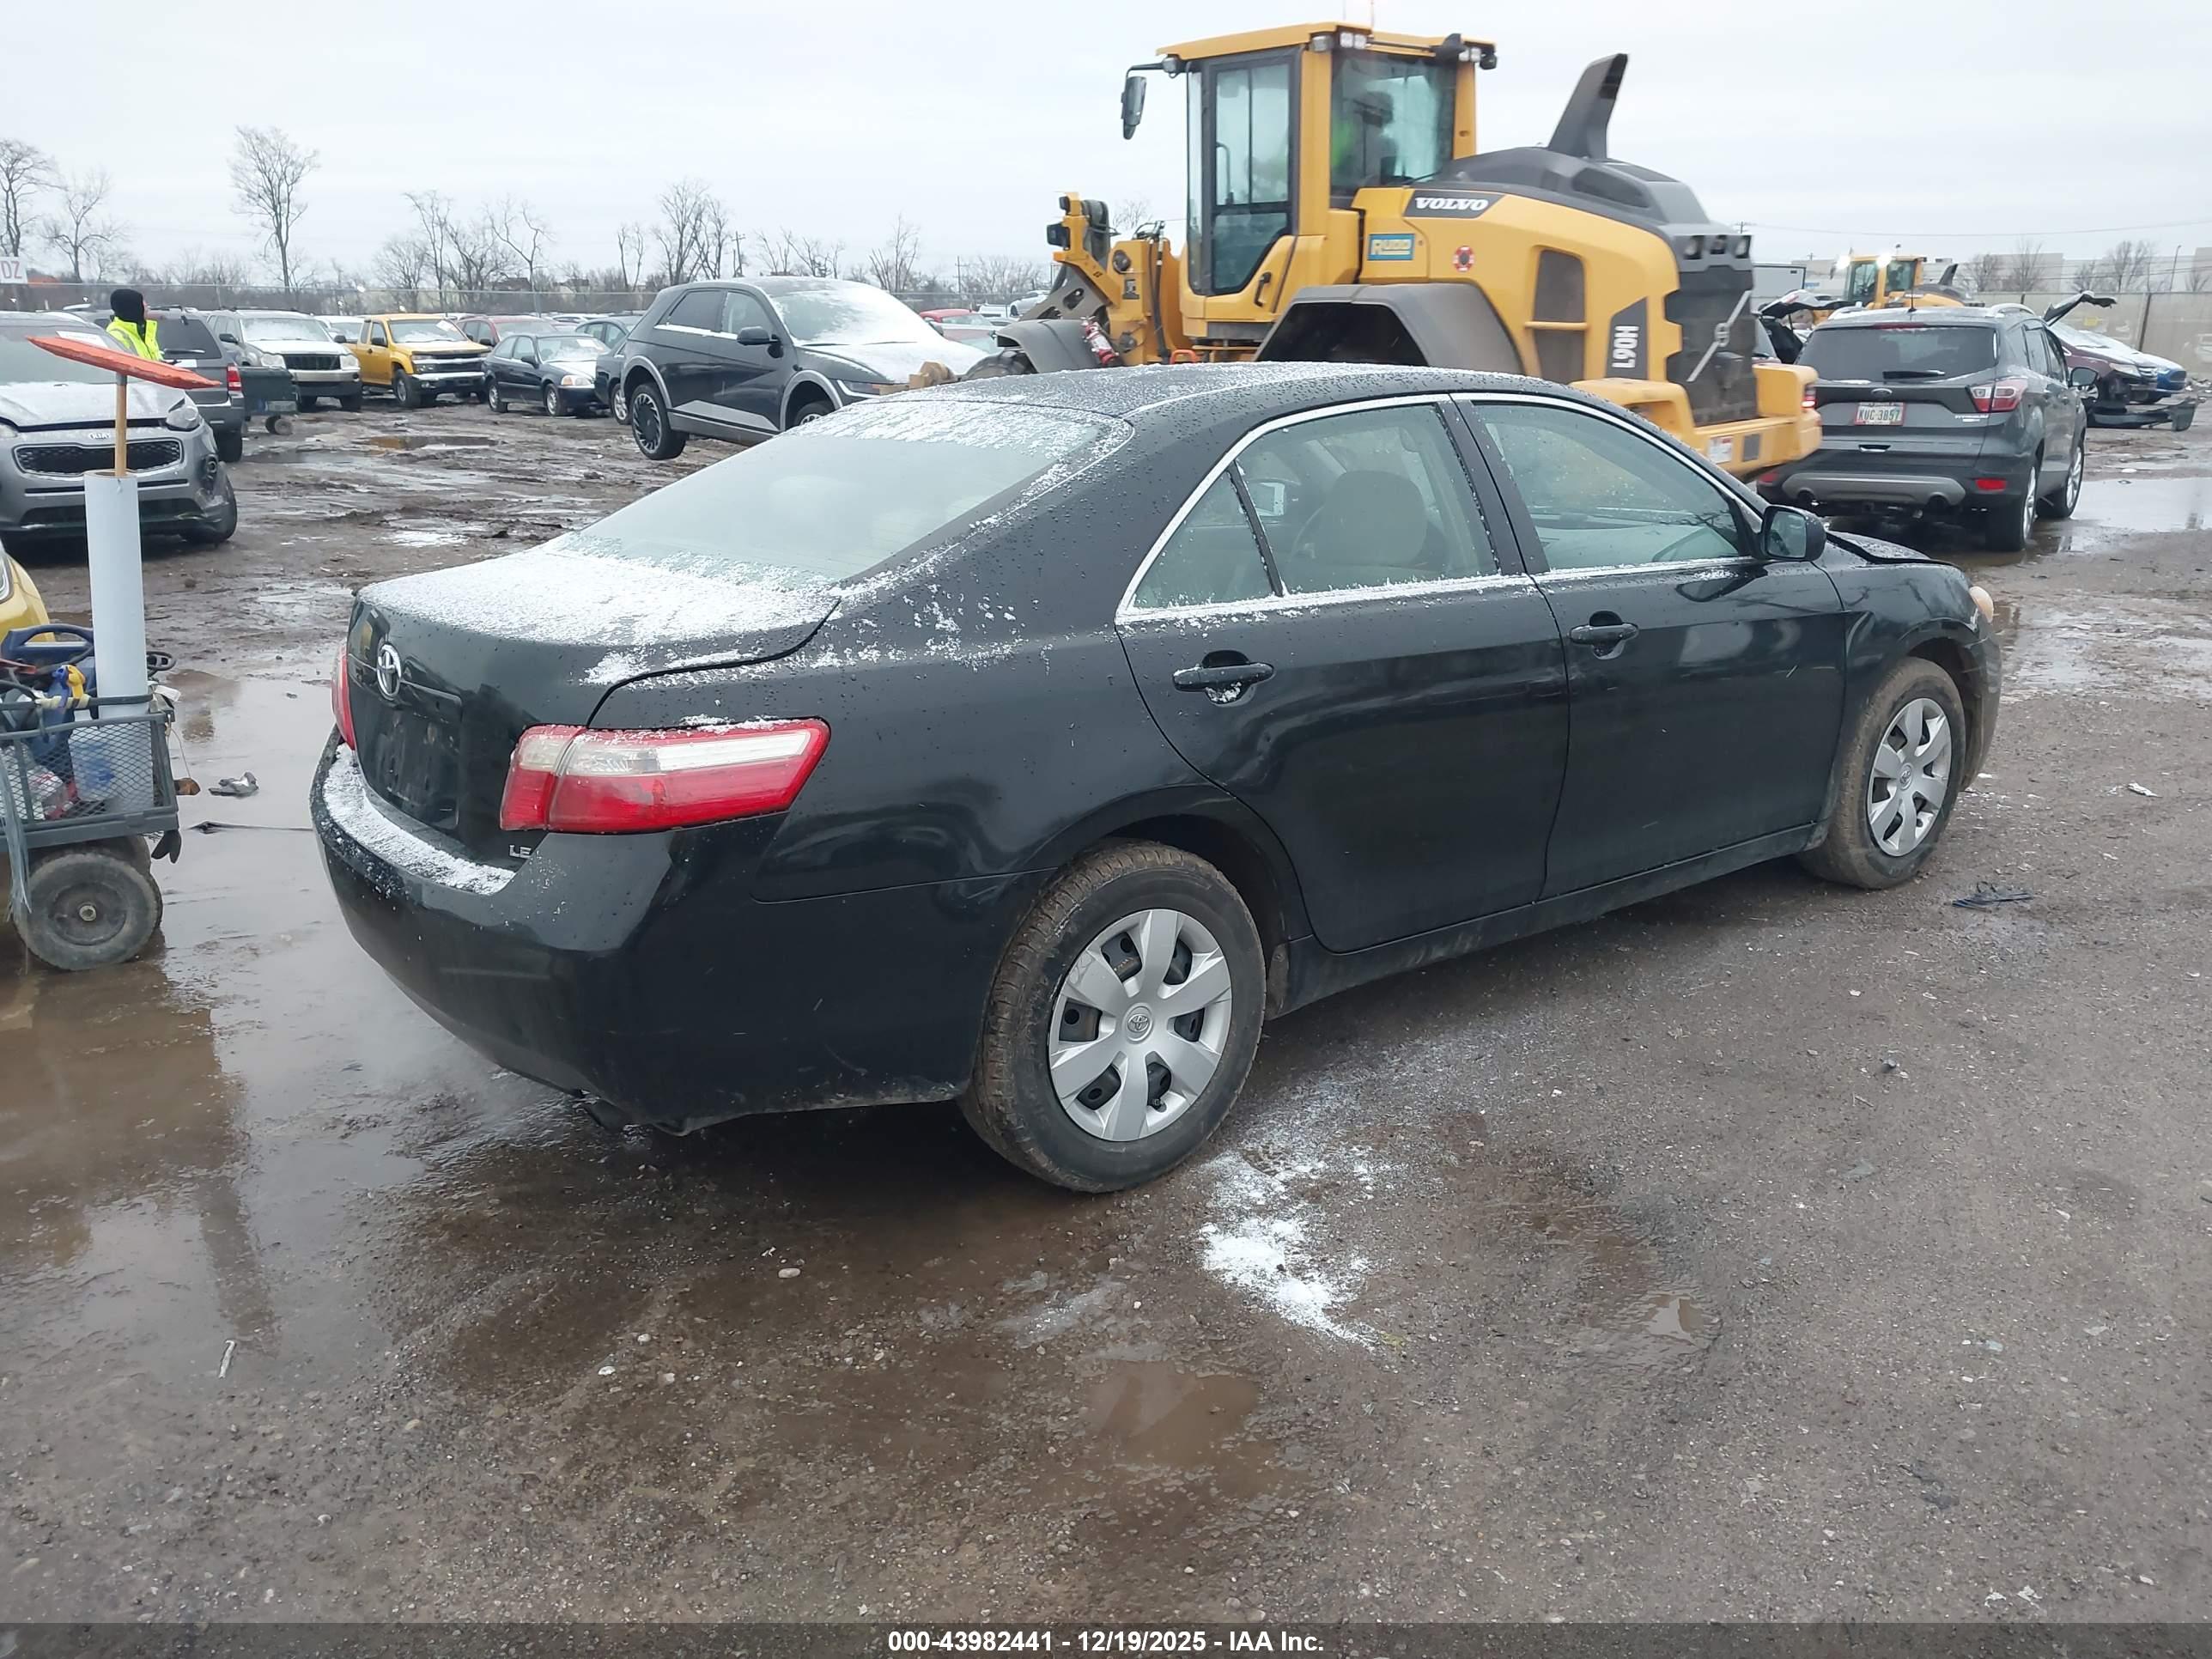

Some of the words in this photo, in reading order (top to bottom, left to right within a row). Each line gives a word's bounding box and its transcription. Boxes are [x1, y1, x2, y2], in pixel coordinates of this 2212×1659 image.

[1415, 197, 1489, 211] VOLVO
[1612, 325, 1639, 368] L90H
[509, 844, 532, 859] LE
